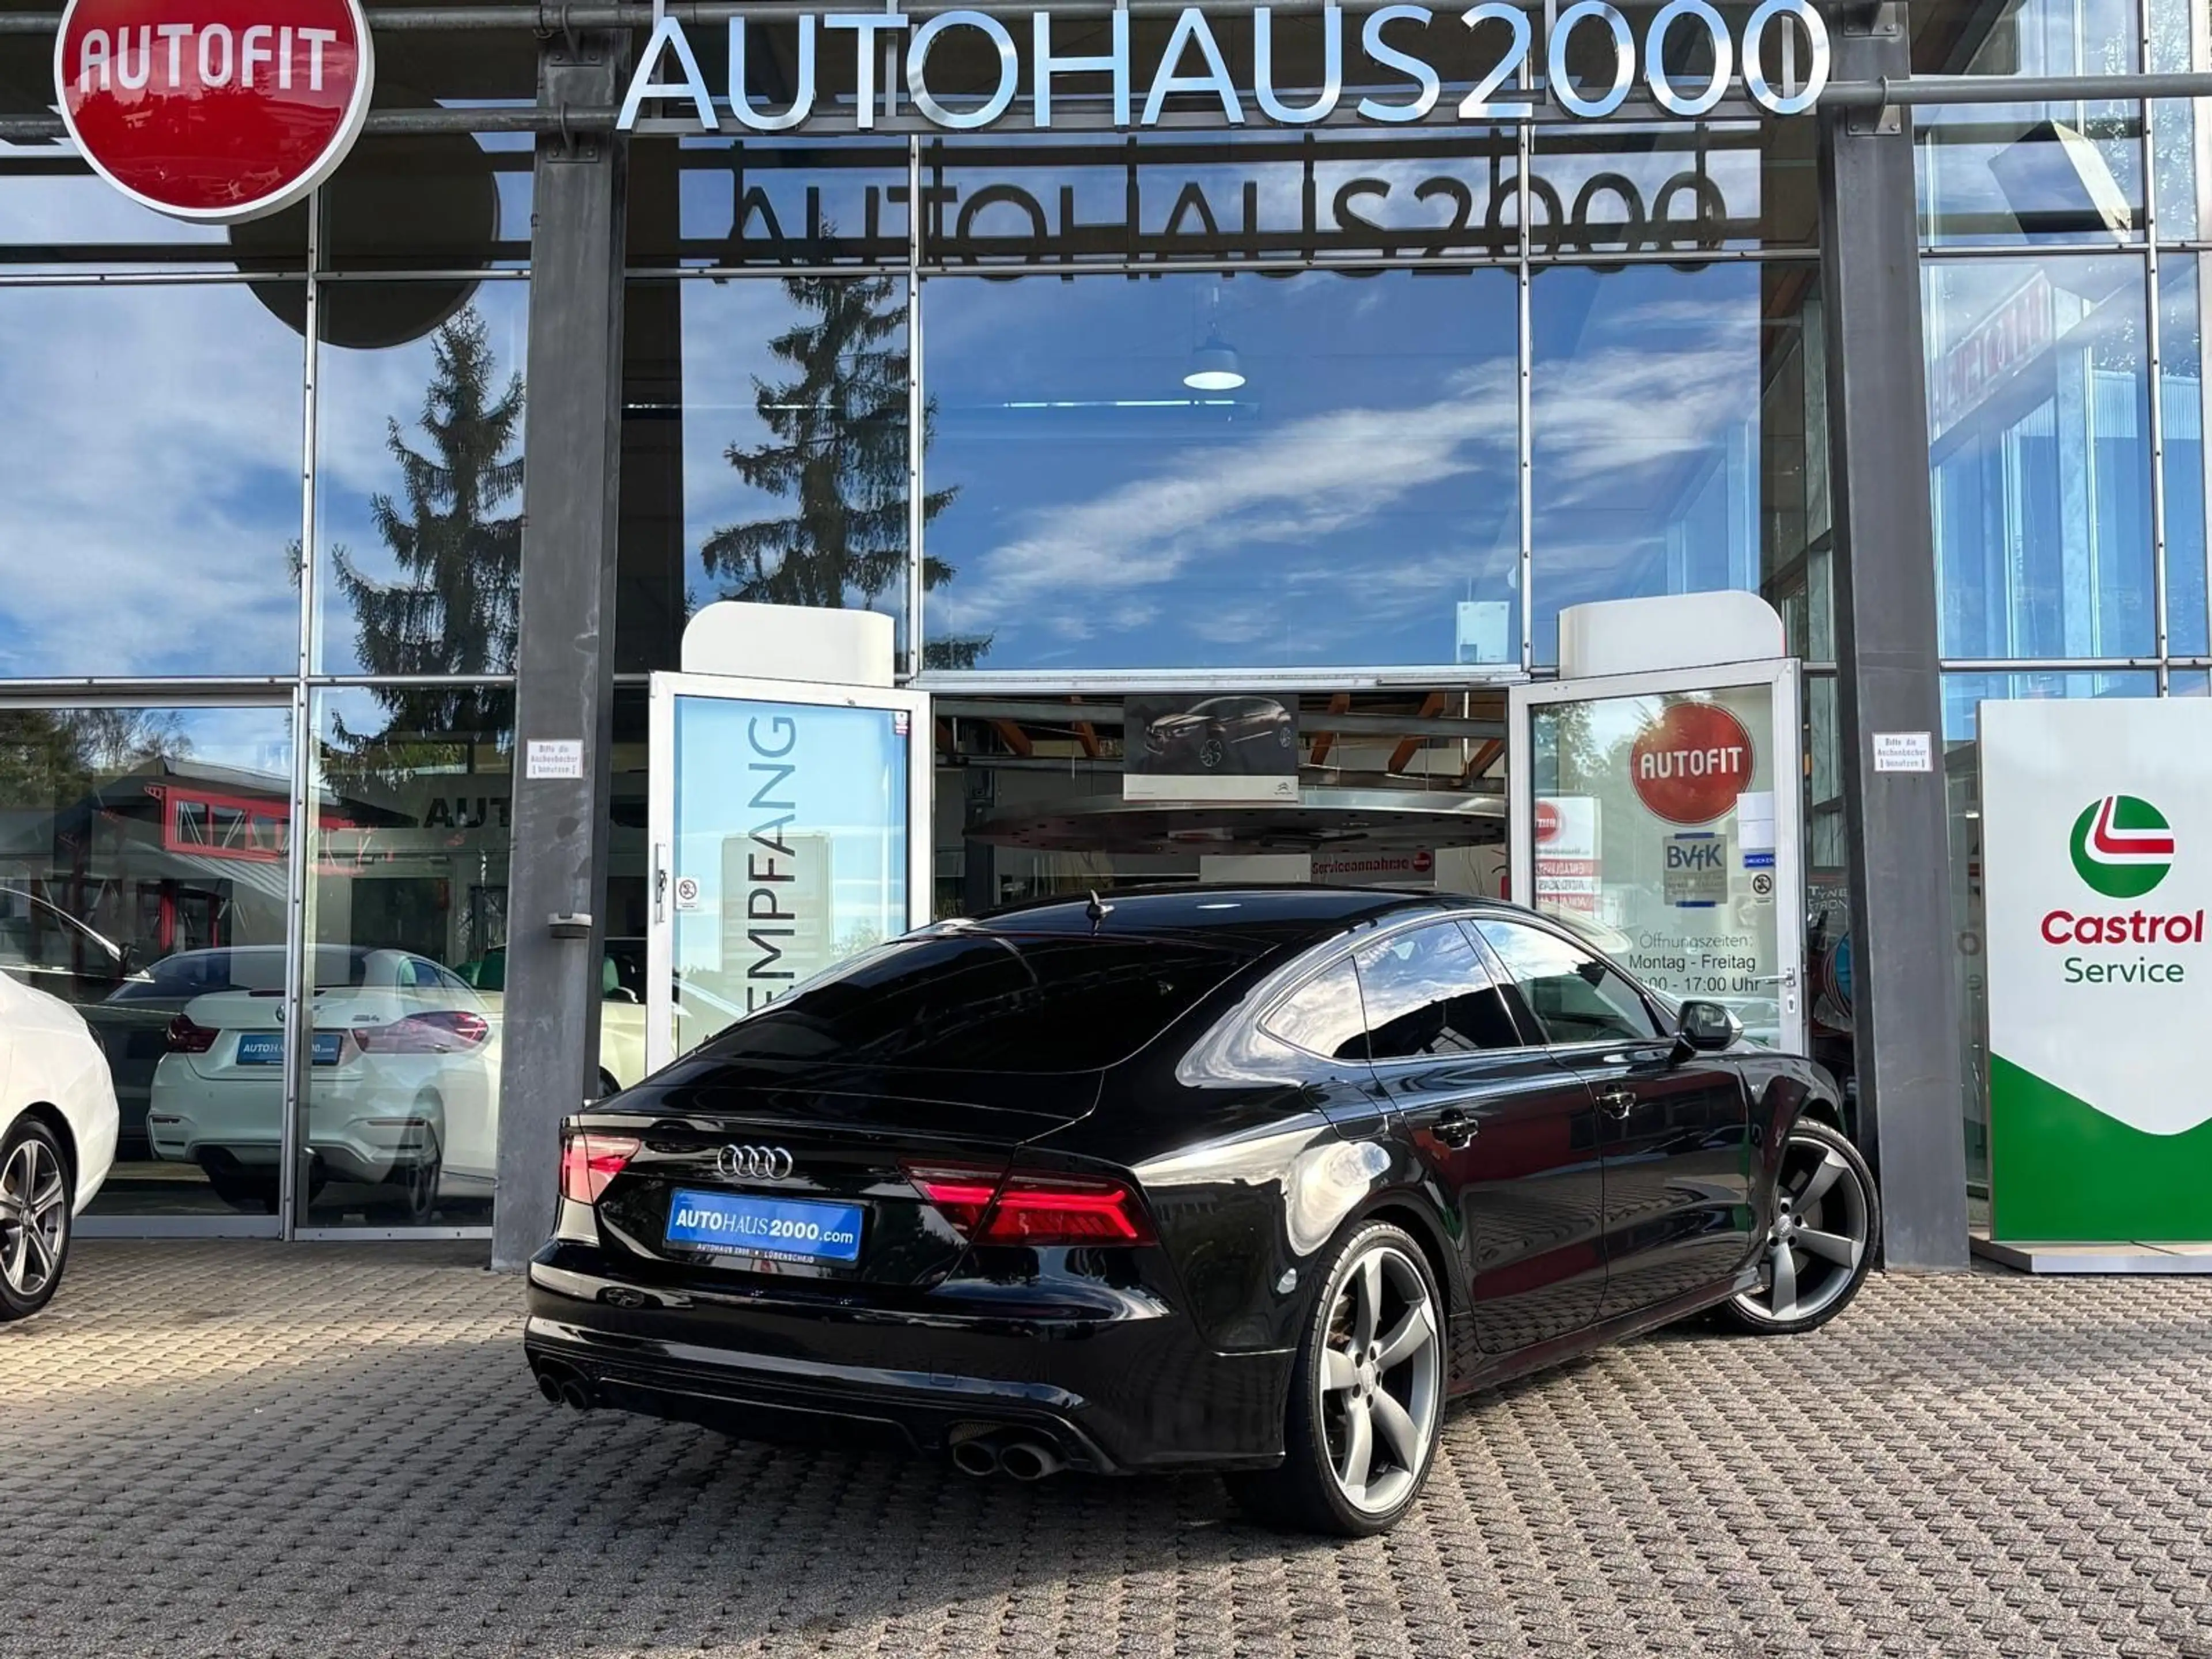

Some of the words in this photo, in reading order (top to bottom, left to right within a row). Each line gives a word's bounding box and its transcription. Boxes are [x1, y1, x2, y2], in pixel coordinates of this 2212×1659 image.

[80, 23, 337, 93] AUTOFIT
[616, 0, 1831, 131] AUTOHAUS2000
[1640, 747, 1743, 779] AUTOFIT
[1639, 930, 1753, 951] Öffnungszeiten:
[2041, 910, 2204, 944] Castrol
[1630, 955, 1685, 972] Montag
[1702, 954, 1755, 972] Freitag
[2064, 957, 2184, 983] Service
[1685, 977, 1726, 991] 17:00
[1732, 978, 1760, 991] Uhr
[676, 1209, 853, 1244] AUTOHAUS2000.com
